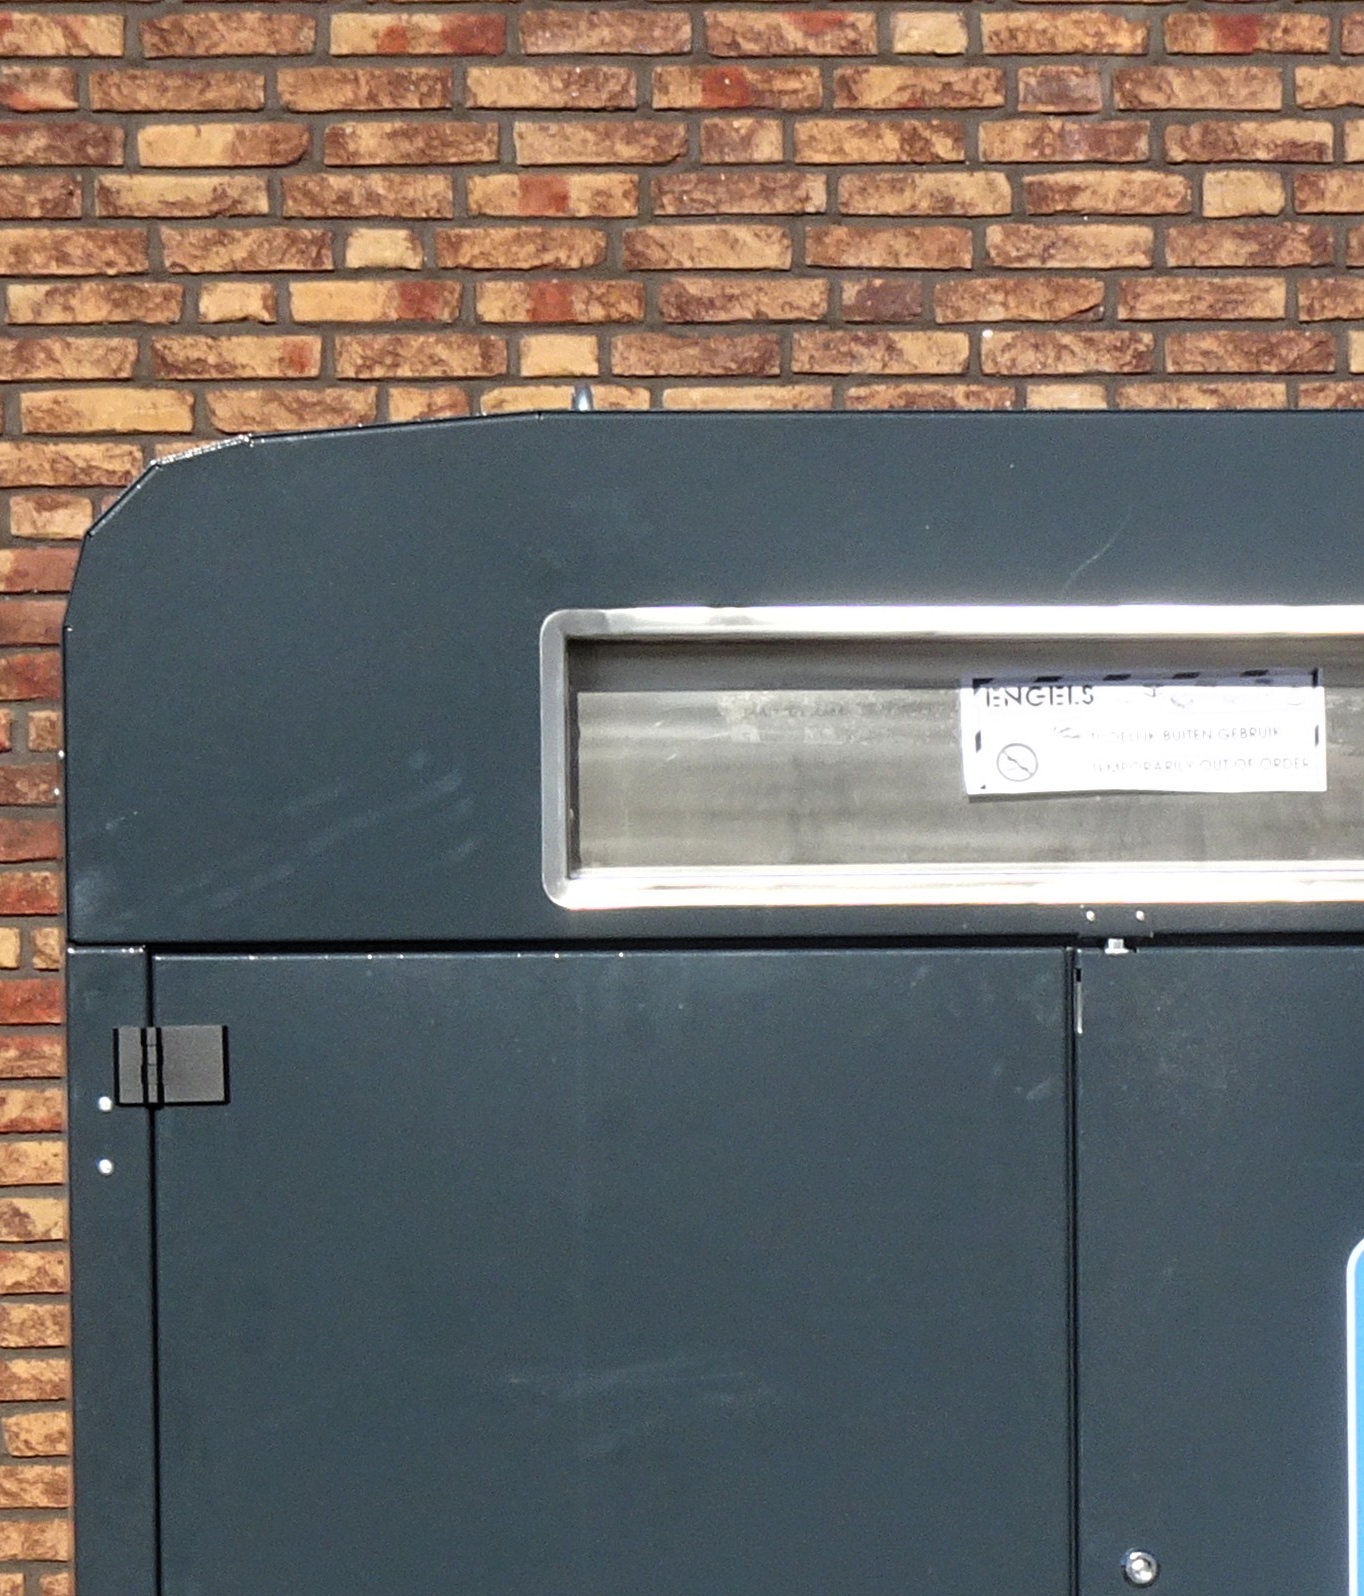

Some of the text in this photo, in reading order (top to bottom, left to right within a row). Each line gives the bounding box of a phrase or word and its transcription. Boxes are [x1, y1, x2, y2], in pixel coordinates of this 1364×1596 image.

[985, 685, 1095, 708] ENGELS
[1090, 726, 1280, 743] TIDELIJK BUITEN GEBRUIK
[1199, 758, 1230, 771] OUT
[1234, 757, 1255, 770] OF
[1260, 756, 1310, 770] ORDER
